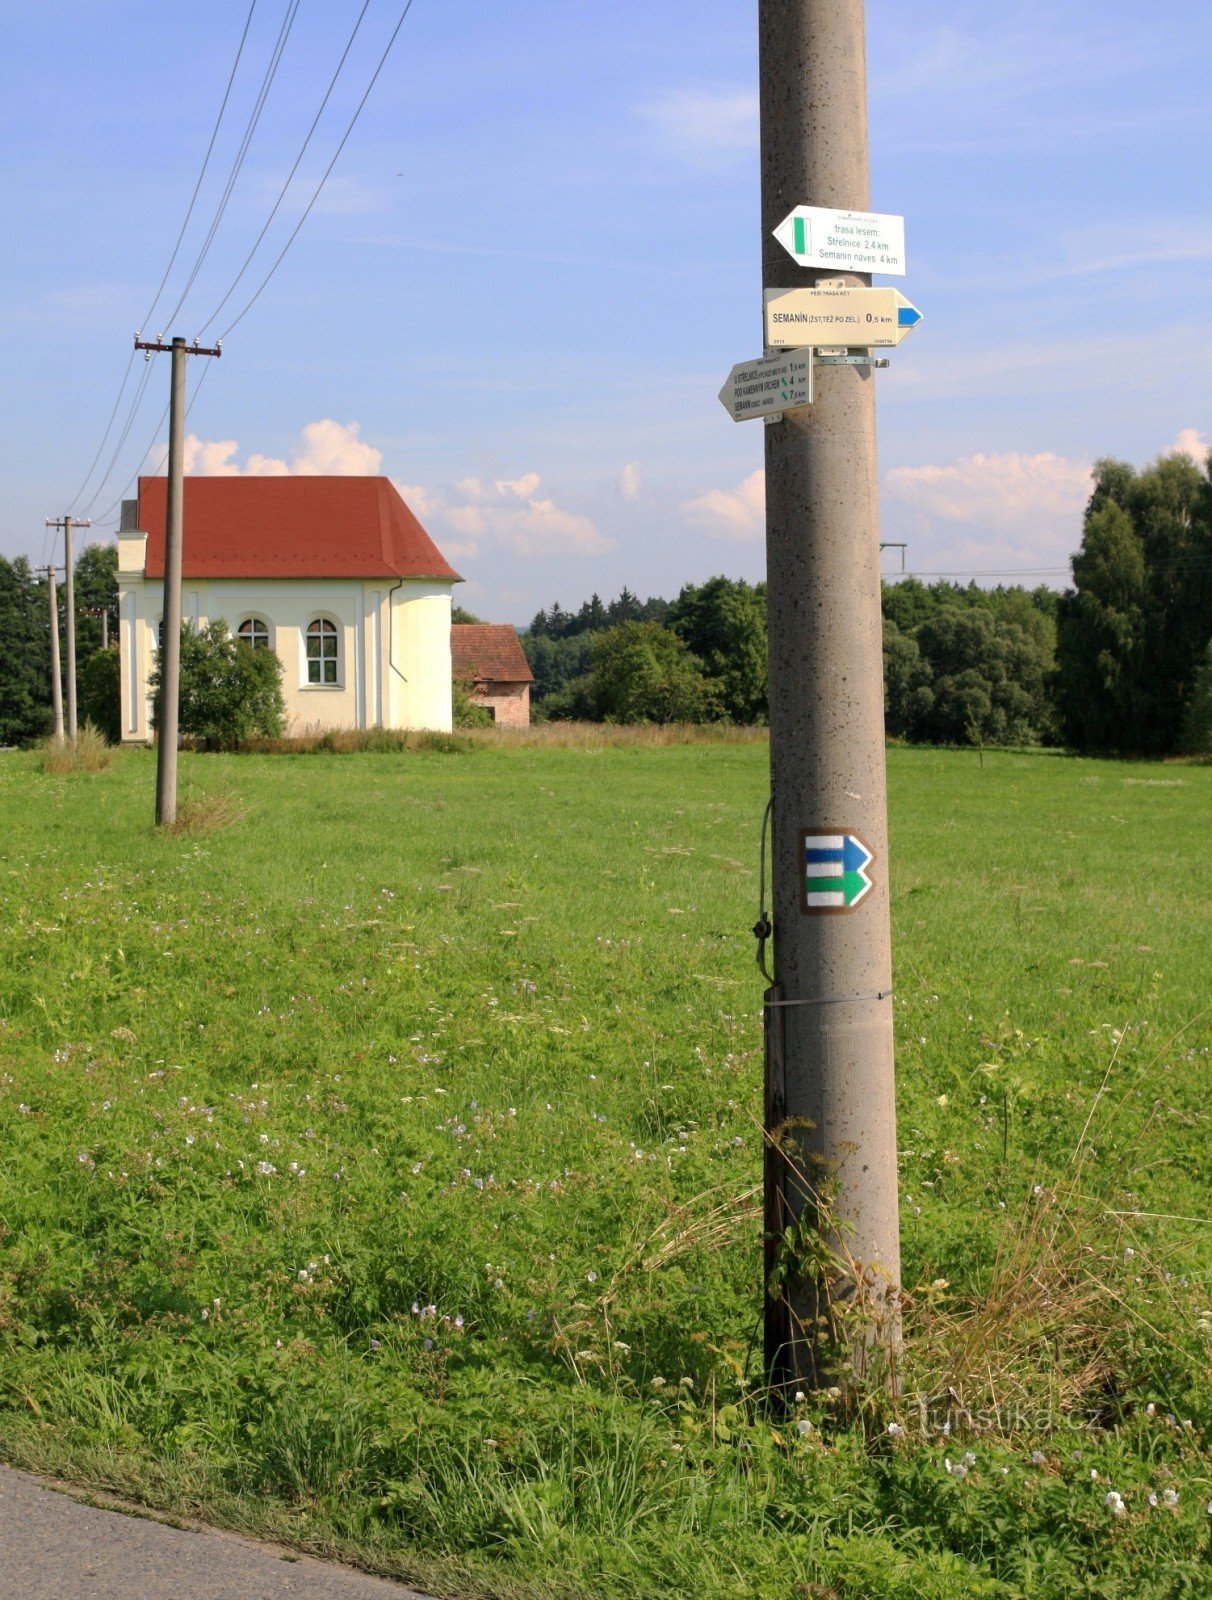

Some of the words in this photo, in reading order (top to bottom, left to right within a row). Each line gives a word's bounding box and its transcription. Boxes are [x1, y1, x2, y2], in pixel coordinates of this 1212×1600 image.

[835, 225, 853, 234] trasa
[856, 225, 880, 237] lesem:
[877, 242, 889, 250] km
[887, 256, 898, 264] km
[773, 311, 808, 323] SEMANÍN
[866, 313, 879, 323] 0,5
[790, 363, 798, 371] 1,5
[790, 376, 794, 385] 4
[790, 391, 798, 400] 7,5
